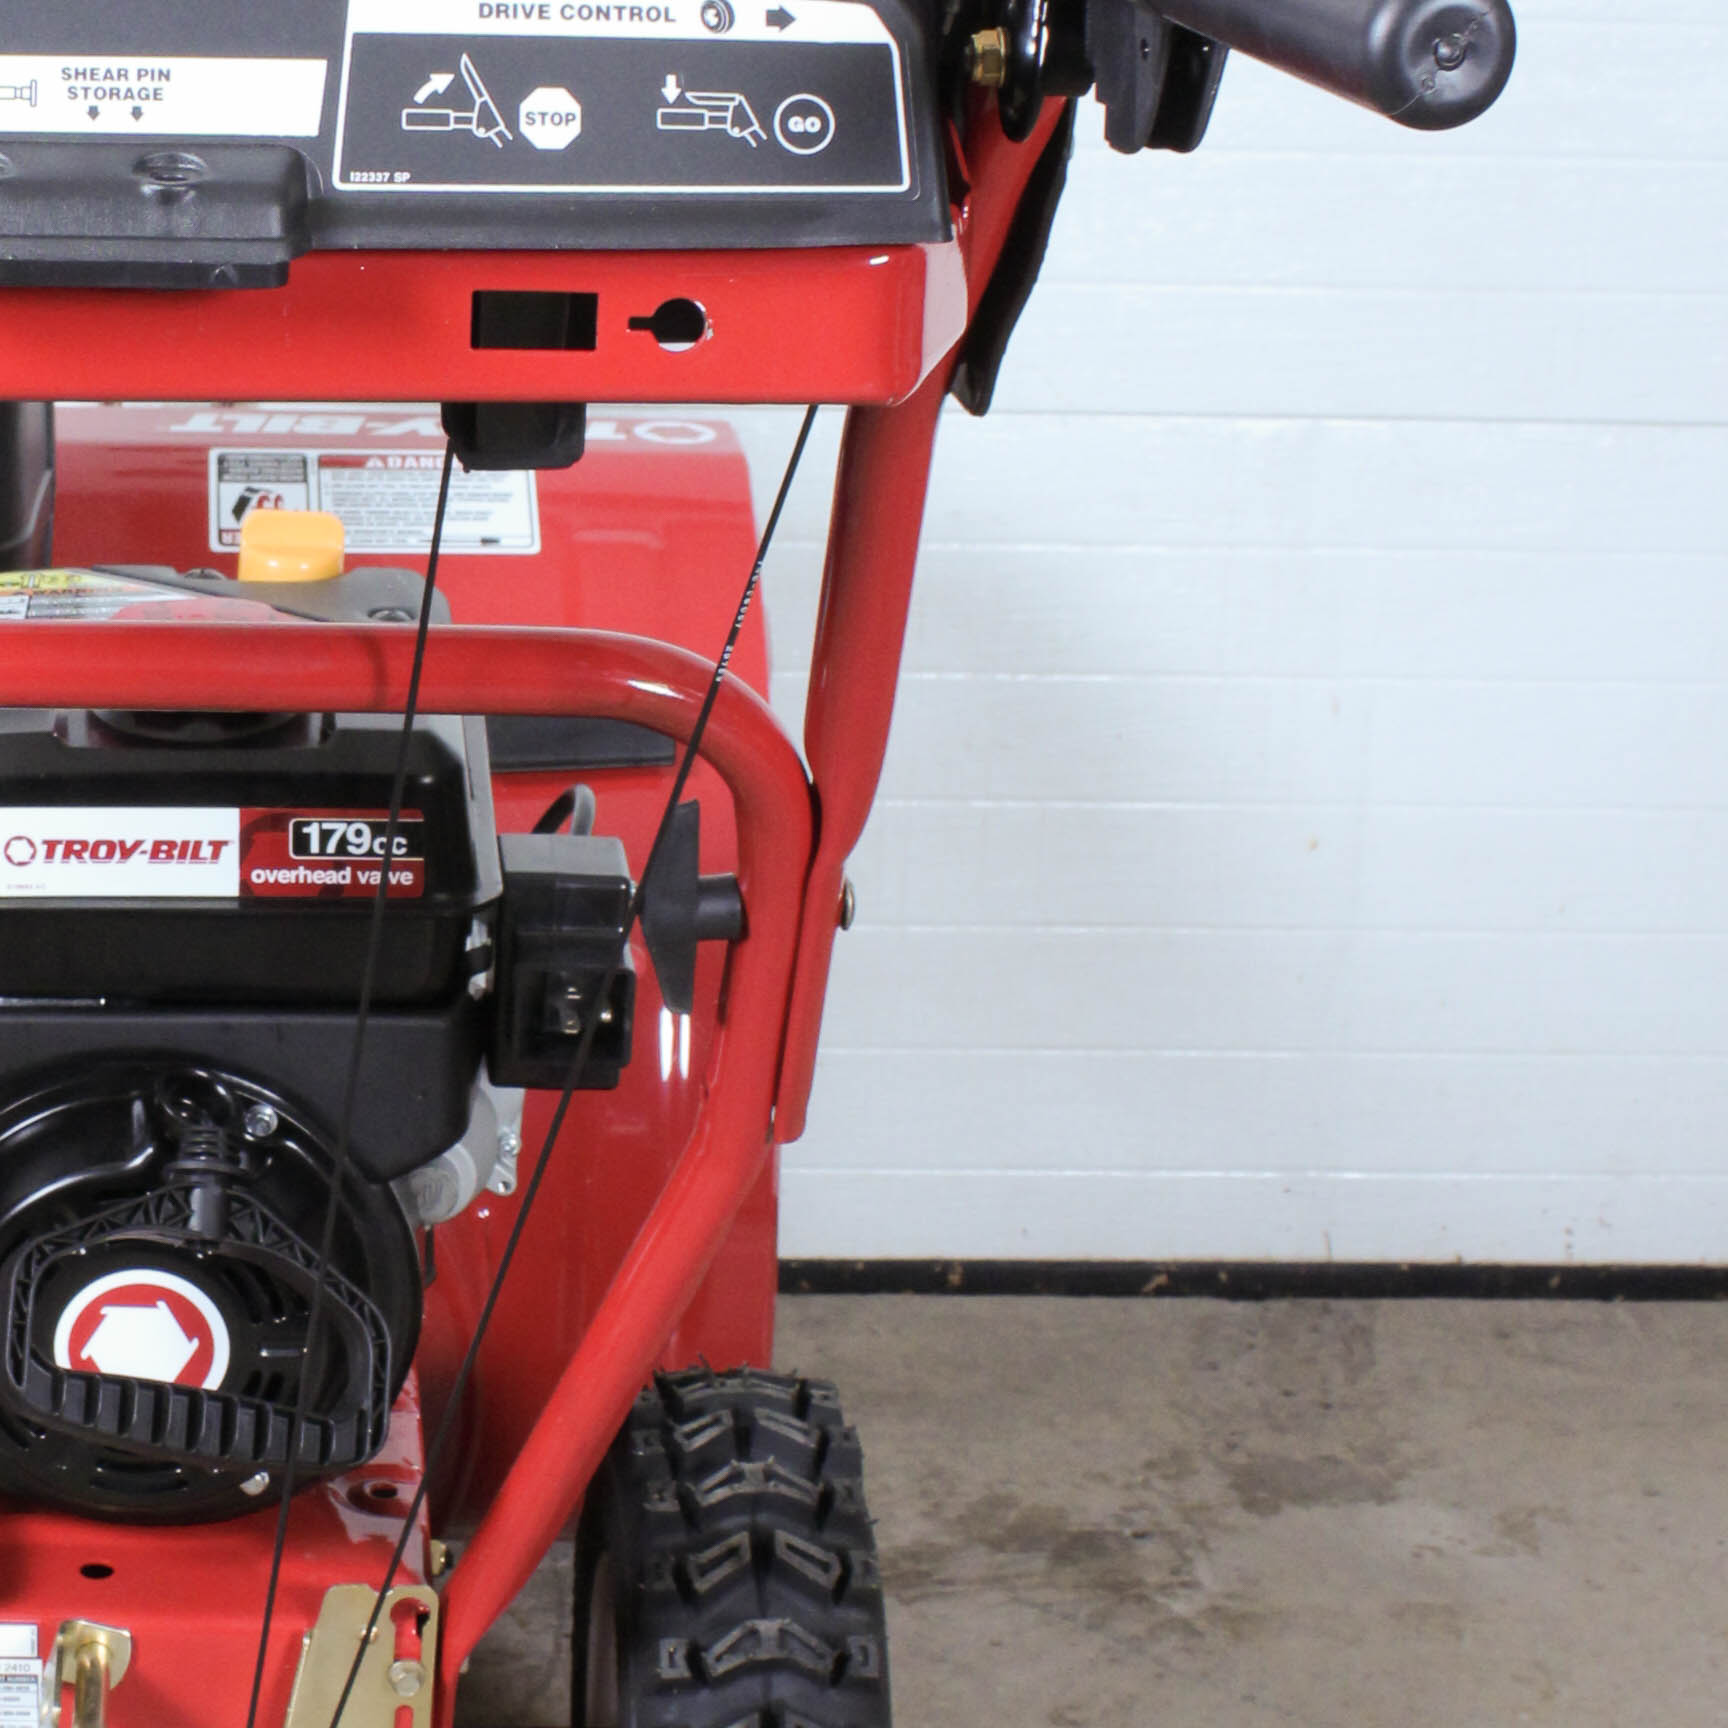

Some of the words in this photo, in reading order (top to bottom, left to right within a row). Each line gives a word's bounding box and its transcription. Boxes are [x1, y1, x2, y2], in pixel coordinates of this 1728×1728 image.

[478, 3, 550, 22] DRIVE
[560, 4, 677, 24] CONTROL
[60, 67, 129, 82] SHEAR
[137, 68, 171, 82] PIN
[67, 86, 165, 102] STORAGE
[525, 111, 577, 128] STOP
[787, 116, 822, 133] GO
[301, 821, 408, 857] 179cc
[42, 838, 232, 865] TROY-BILT
[250, 866, 352, 886] overhead
[356, 868, 414, 886] vave
[4, 1663, 31, 1672] 2410
